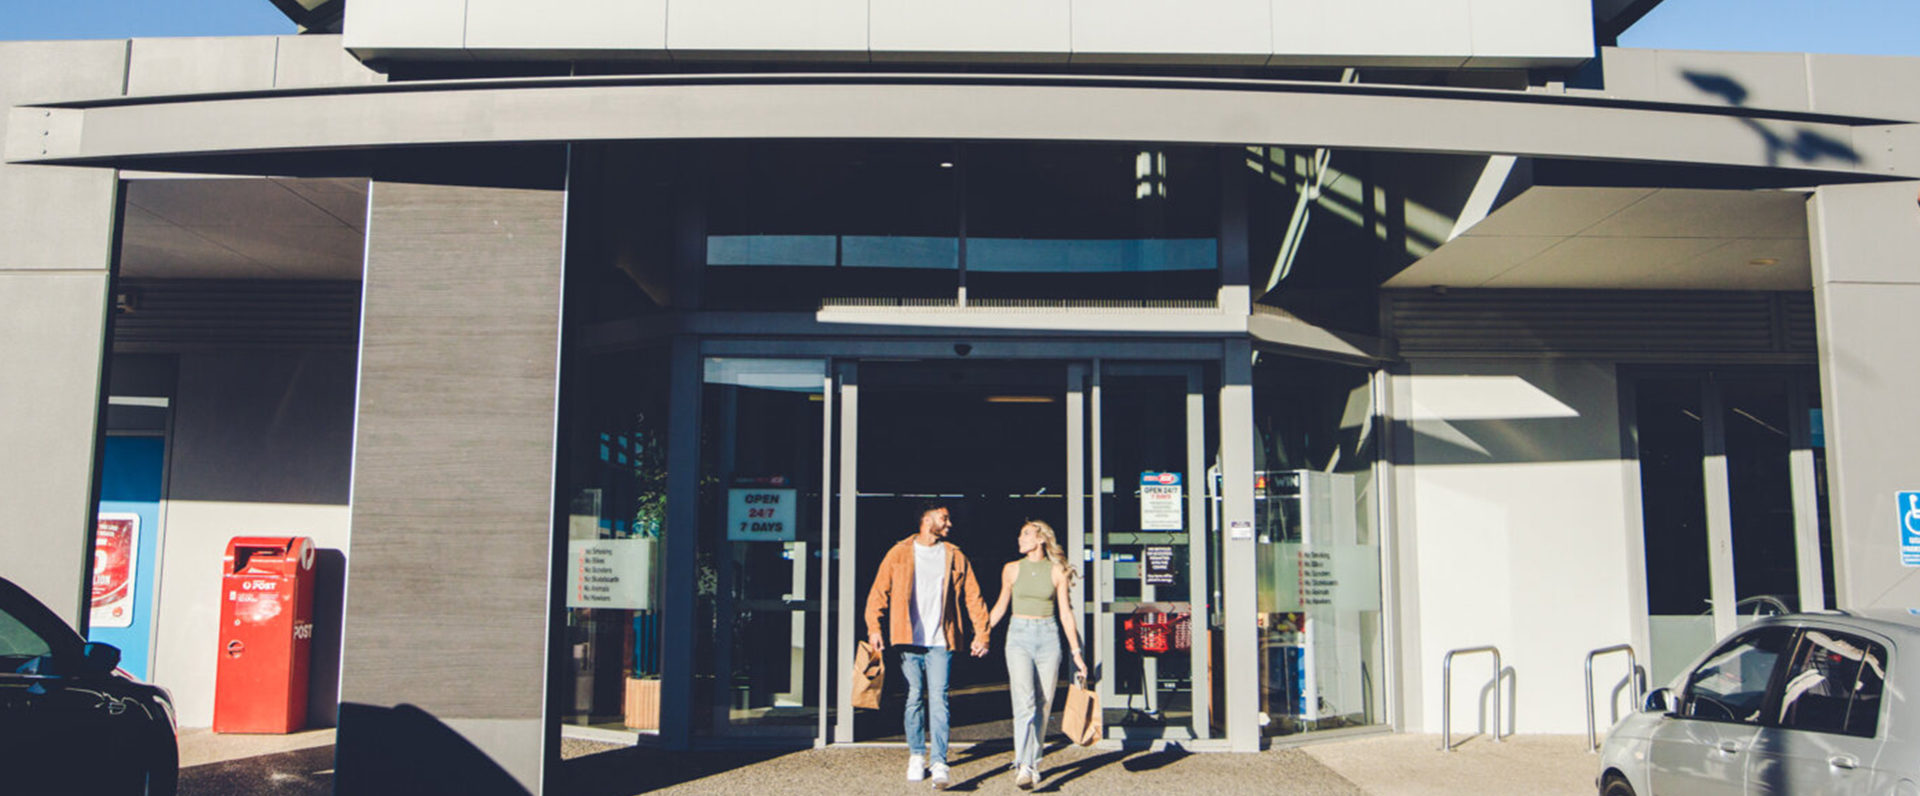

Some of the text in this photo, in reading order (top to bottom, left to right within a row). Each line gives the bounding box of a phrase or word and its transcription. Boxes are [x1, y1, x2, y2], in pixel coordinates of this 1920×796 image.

[745, 494, 780, 504] OPEN
[748, 508, 775, 518] 24/7
[740, 522, 784, 532] 7 DAYS
[252, 581, 277, 590] POST
[293, 624, 313, 639] POST
